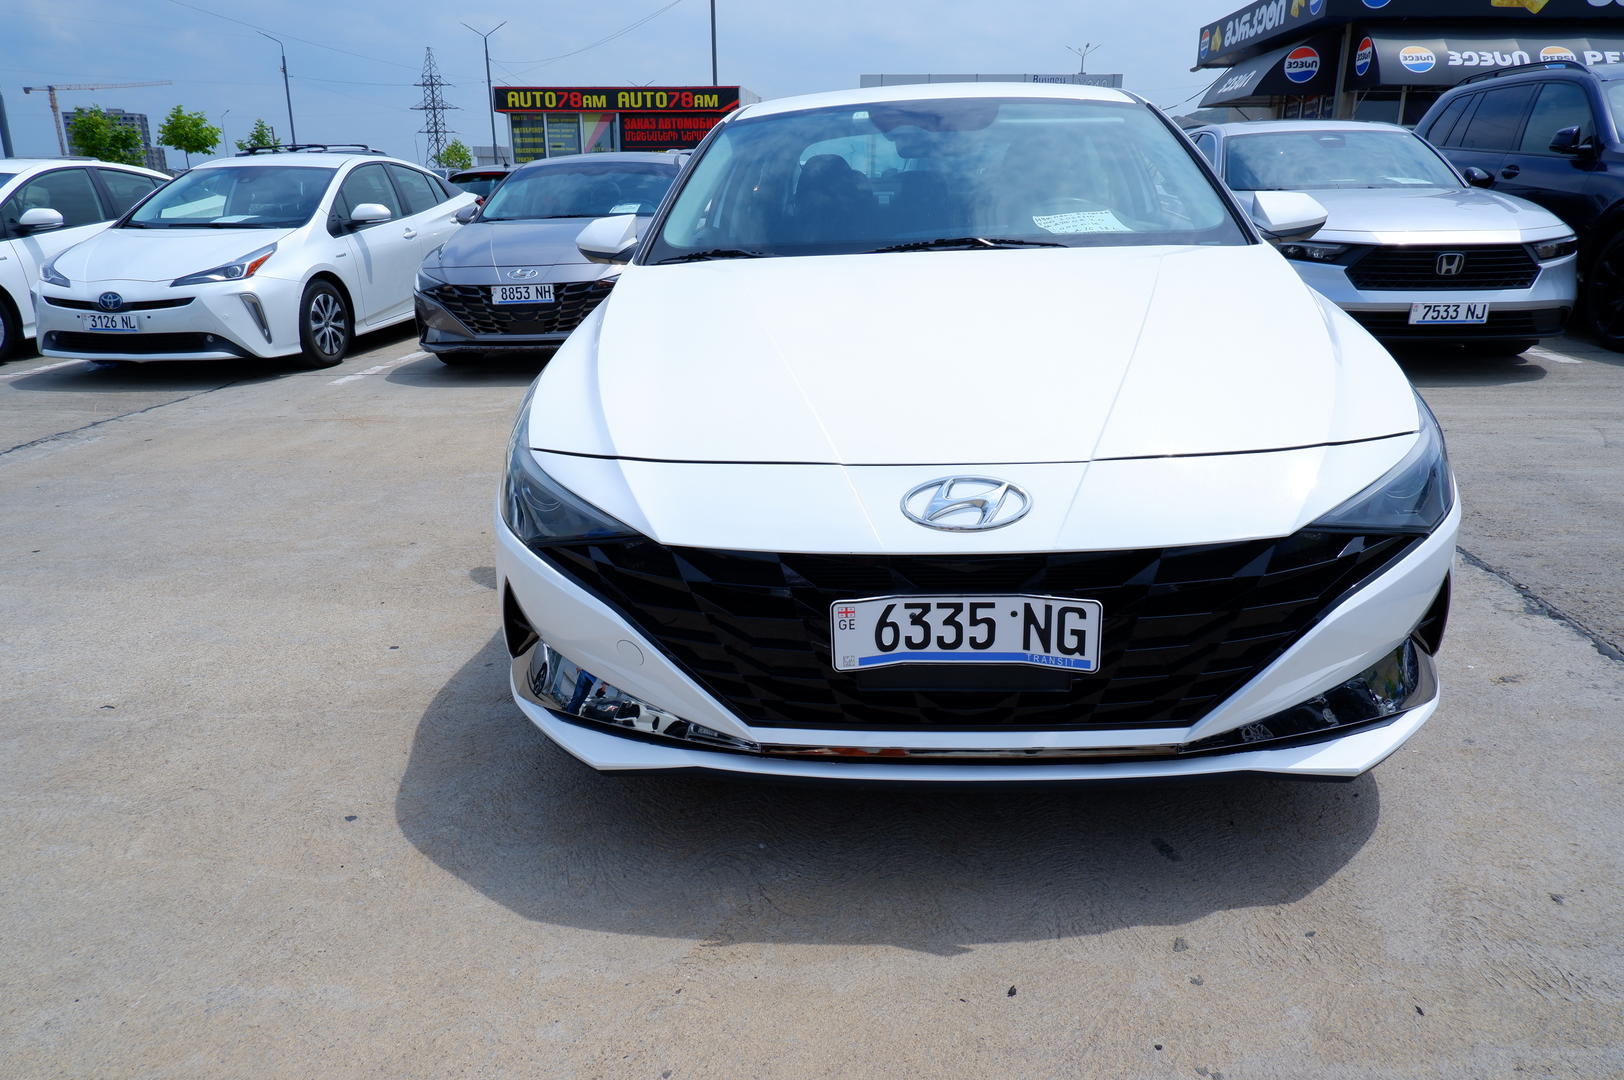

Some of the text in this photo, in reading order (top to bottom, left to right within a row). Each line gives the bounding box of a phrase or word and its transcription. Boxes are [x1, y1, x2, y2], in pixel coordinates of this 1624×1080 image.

[1224, 0, 1287, 48] მარკეტი
[1286, 60, 1318, 69] პეპსი
[1448, 51, 1530, 67] პეპსი
[1584, 51, 1624, 66] PE
[507, 91, 719, 108] AUTO78AM AUTO78AM
[624, 118, 657, 130] ЗАКАЗ
[501, 285, 551, 300] 8853 NH
[1422, 304, 1487, 320] 7533 NJ
[90, 315, 136, 329] 3126 NL
[838, 619, 856, 631] GE
[874, 602, 1087, 656] 6335 NG
[1027, 653, 1077, 667] TRANSIT
